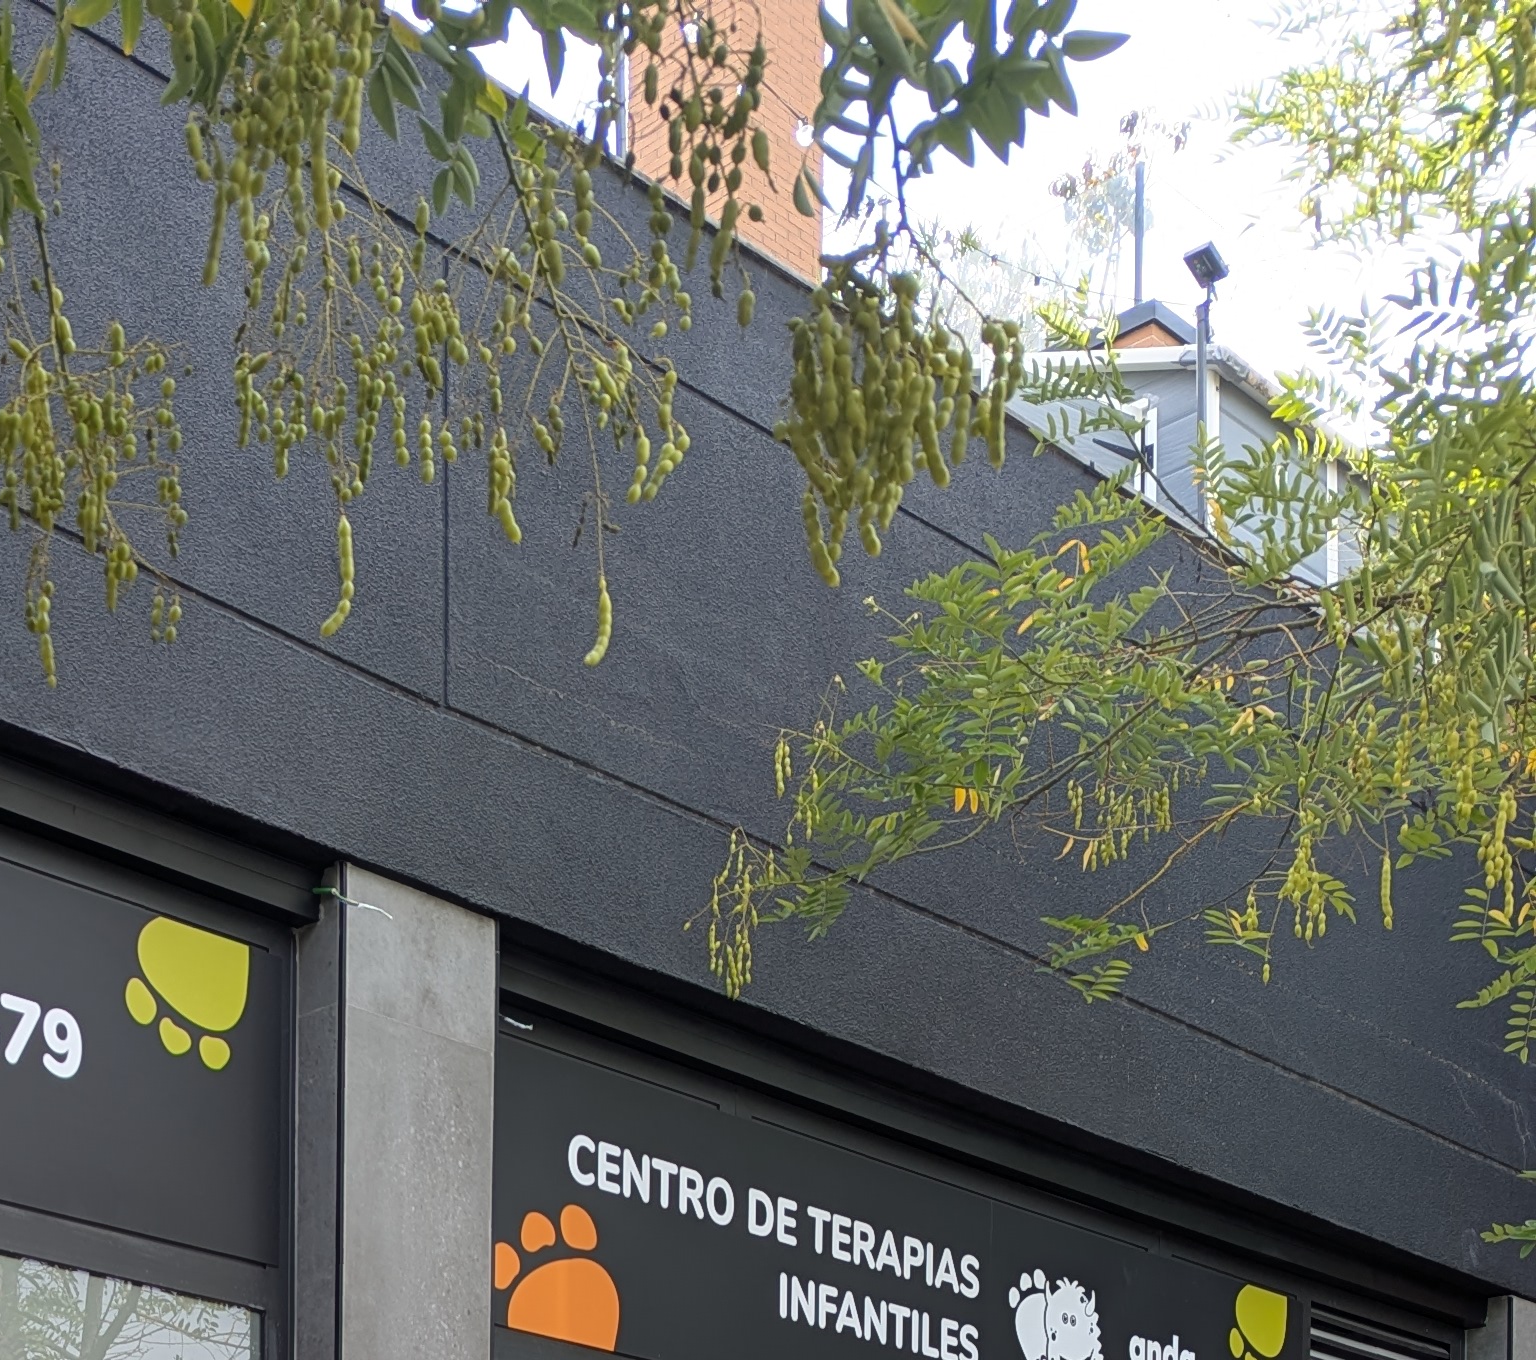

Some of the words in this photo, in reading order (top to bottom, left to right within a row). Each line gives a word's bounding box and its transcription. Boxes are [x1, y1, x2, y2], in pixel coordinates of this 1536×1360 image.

[567, 1133, 734, 1227] CENTRO
[748, 1187, 798, 1248] DE
[807, 1208, 980, 1299] TERAPIAS
